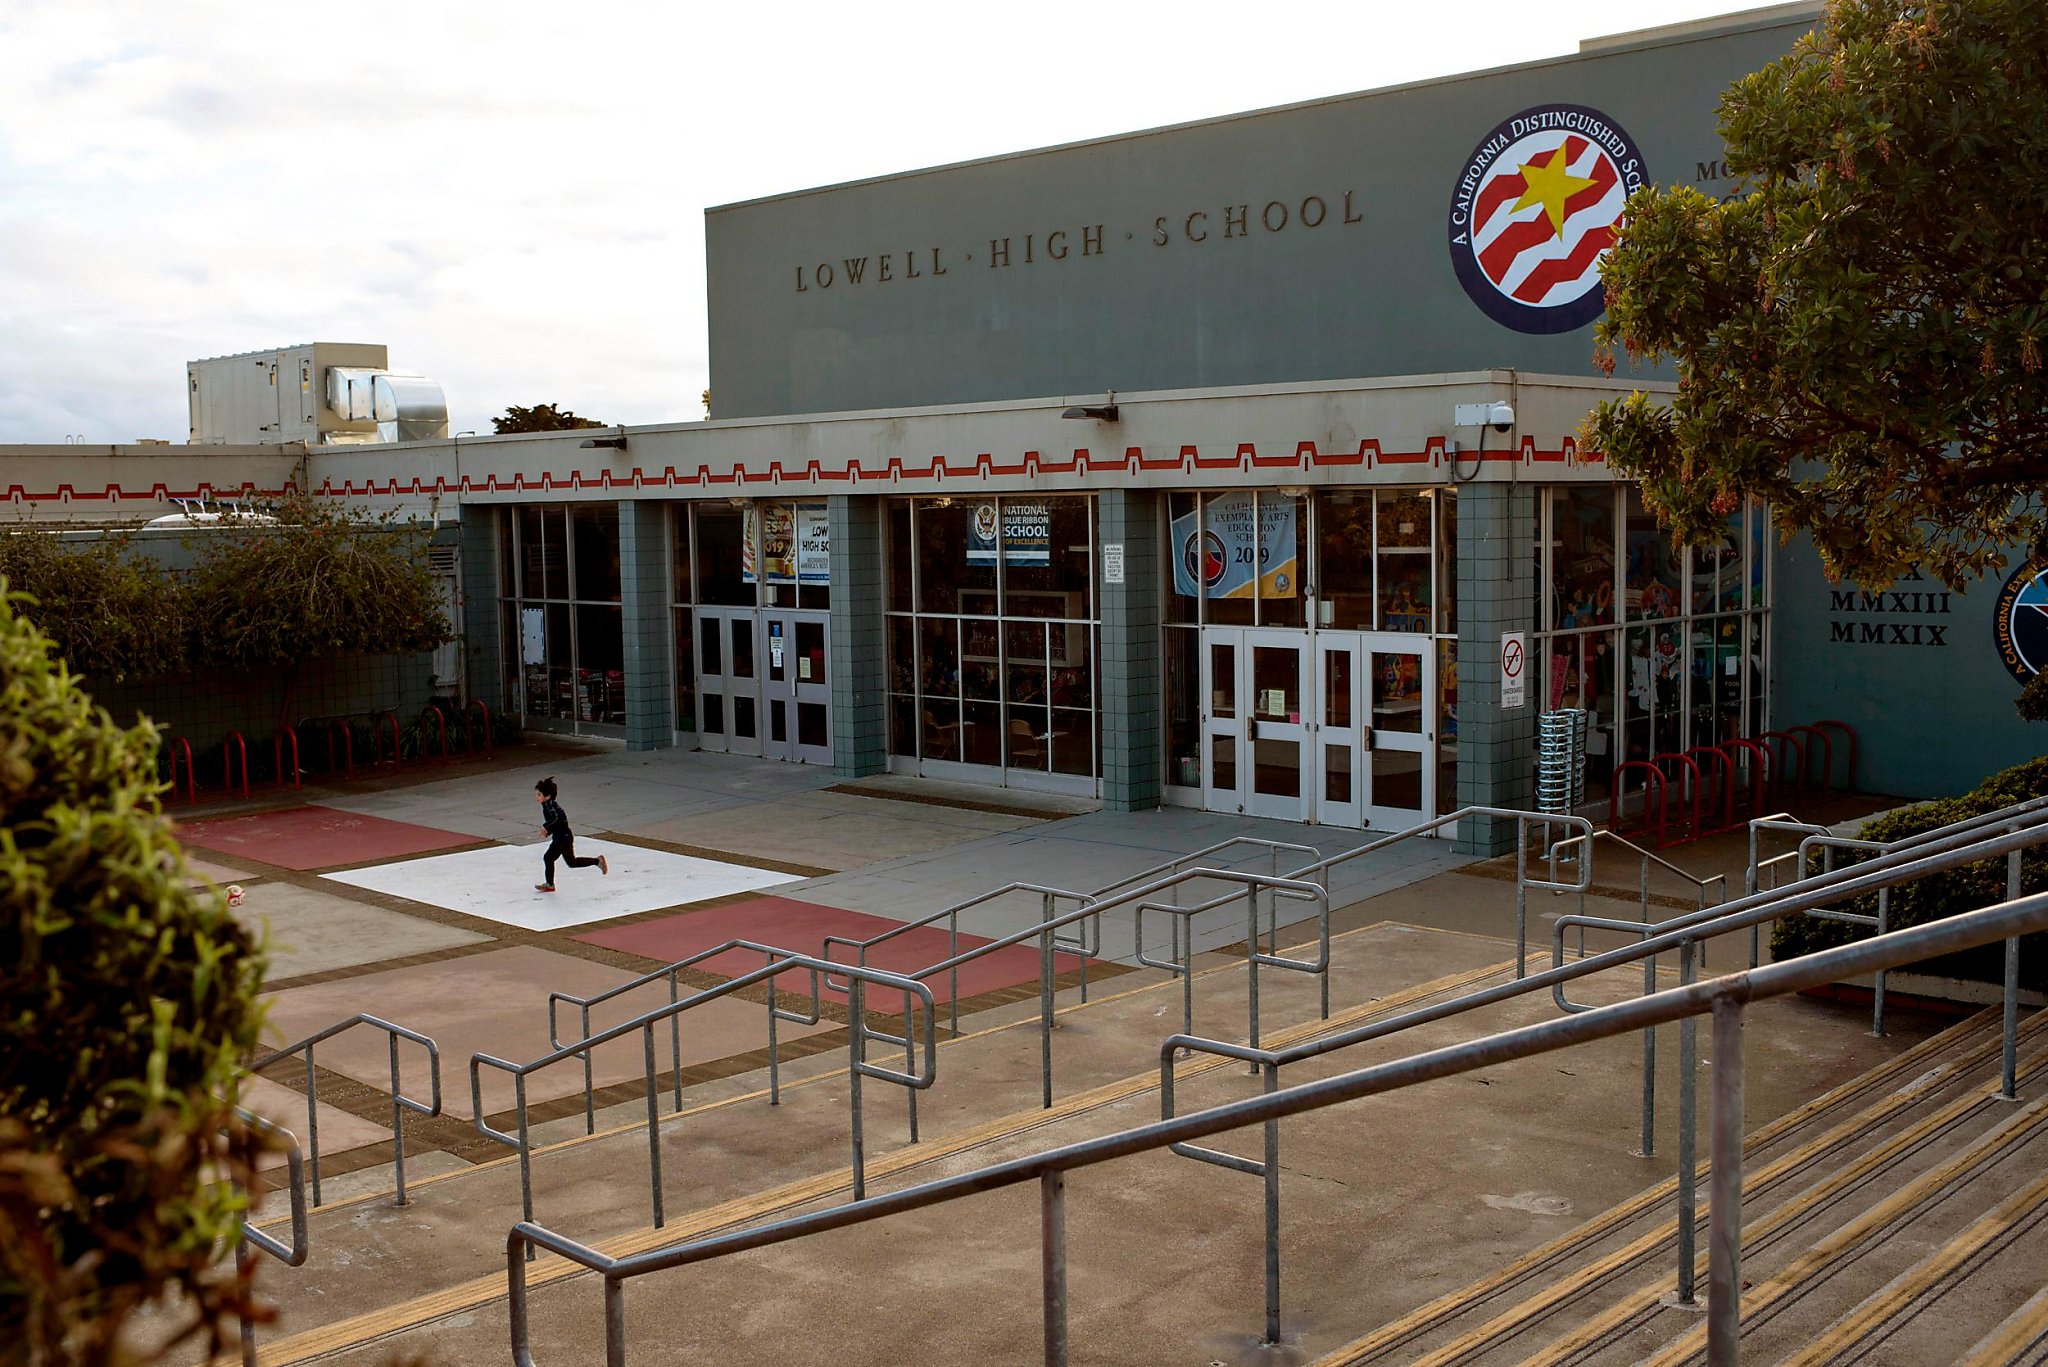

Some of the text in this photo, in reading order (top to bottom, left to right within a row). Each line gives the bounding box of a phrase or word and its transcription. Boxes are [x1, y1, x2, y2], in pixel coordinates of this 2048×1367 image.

[1452, 111, 1642, 246] A CALIFORNIA DISTINGUISHED SCH
[795, 190, 1363, 292] LOWELL HIGH SCHOOL
[1004, 505, 1048, 515] NATIONAL
[1225, 502, 1278, 511] CALIFONIA
[1004, 516, 1049, 524] BLUE RIBBON
[1215, 511, 1289, 522] EXEMPLAY ARTS
[764, 520, 785, 534] EST
[812, 526, 829, 537] LOW
[1005, 526, 1049, 537] SCHOOL
[1227, 523, 1276, 532] EDUCAION
[1236, 532, 1267, 542] SCHL
[764, 541, 784, 552] 019
[802, 541, 819, 552] HIGH
[1235, 547, 1269, 564] 209
[1830, 590, 1951, 613] MMXIII
[1830, 622, 1948, 646] MMXIX
[1998, 595, 2017, 664] CALIFORNIA
[2015, 664, 2026, 674] A
